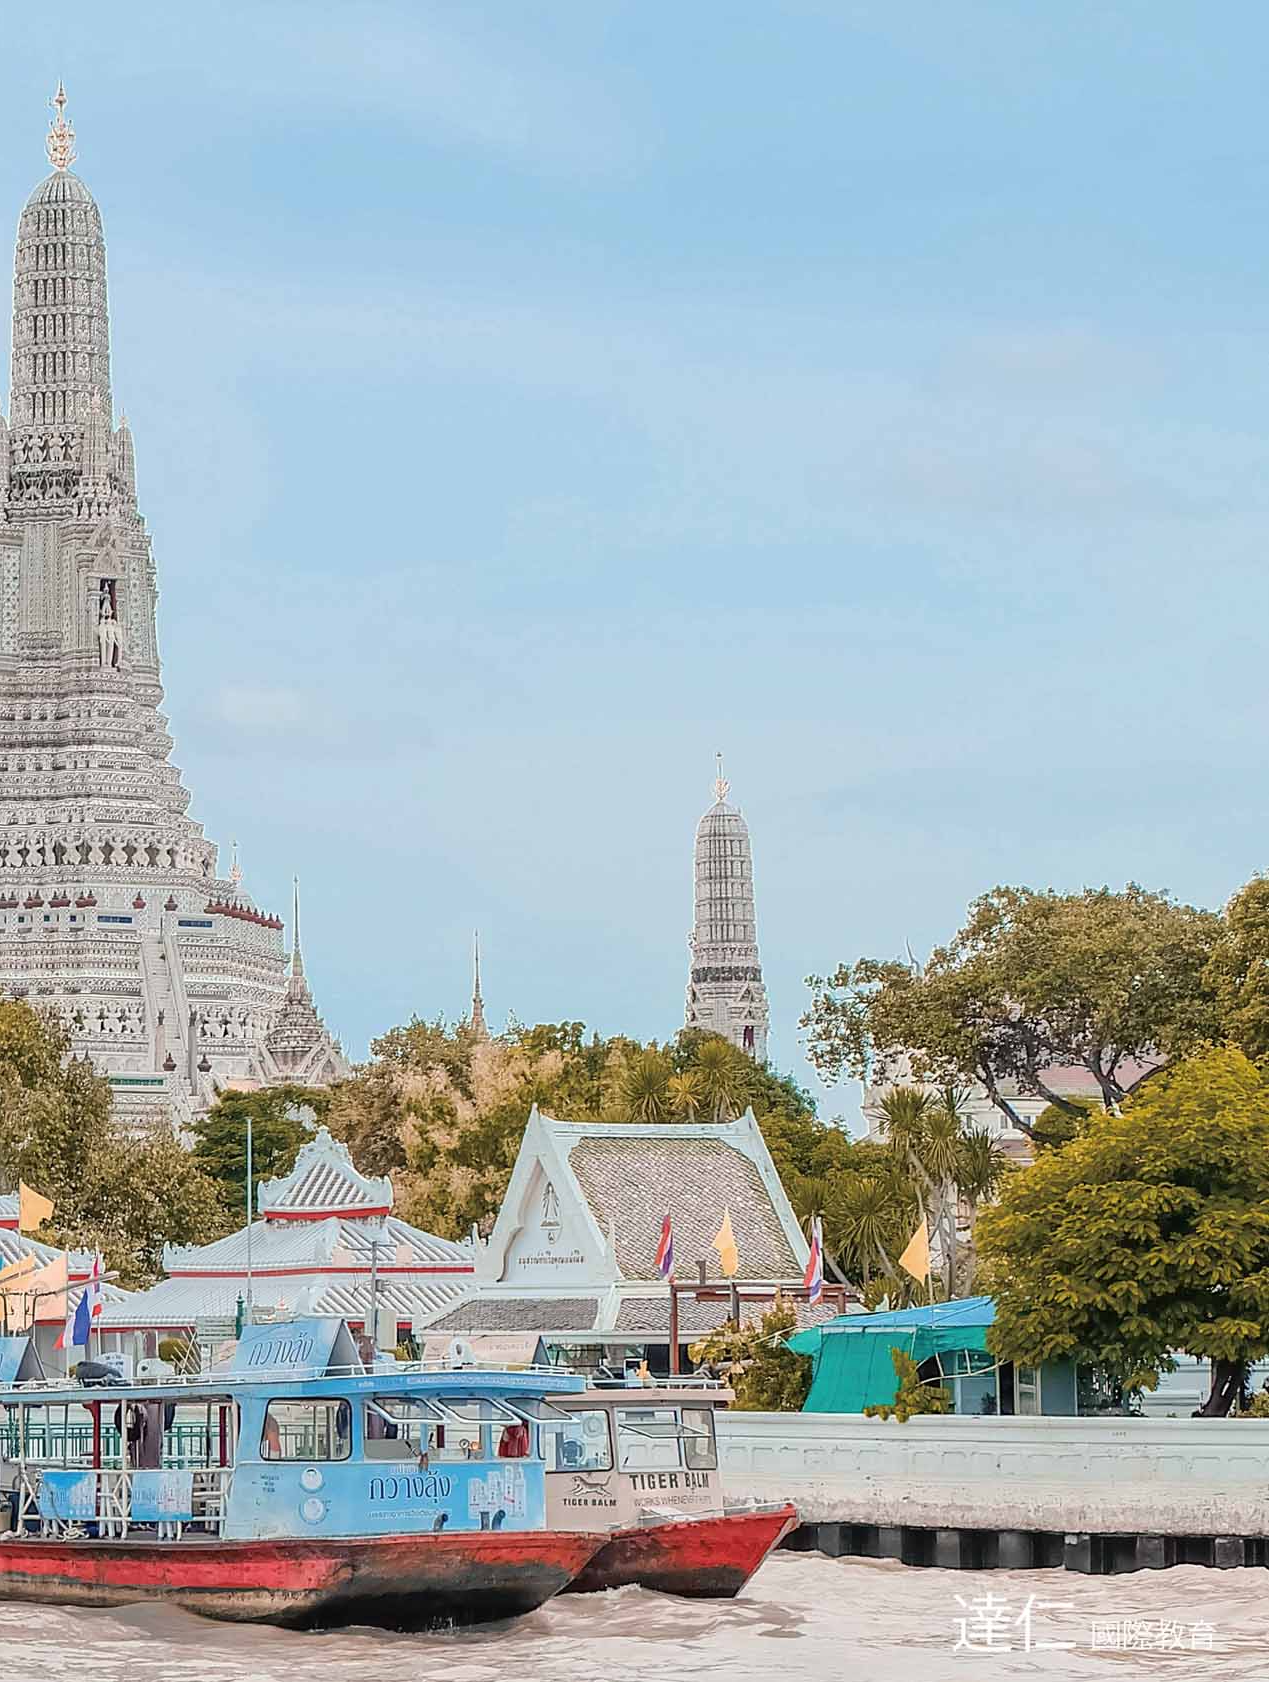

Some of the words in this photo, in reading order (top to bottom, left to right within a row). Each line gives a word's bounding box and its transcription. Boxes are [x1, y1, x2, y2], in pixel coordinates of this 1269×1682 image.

[370, 1470, 451, 1504] กวางลุ้ง
[628, 1472, 679, 1491] TIGER
[684, 1472, 710, 1489] BALM
[563, 1498, 588, 1507] TIGER
[591, 1498, 617, 1507] BALM
